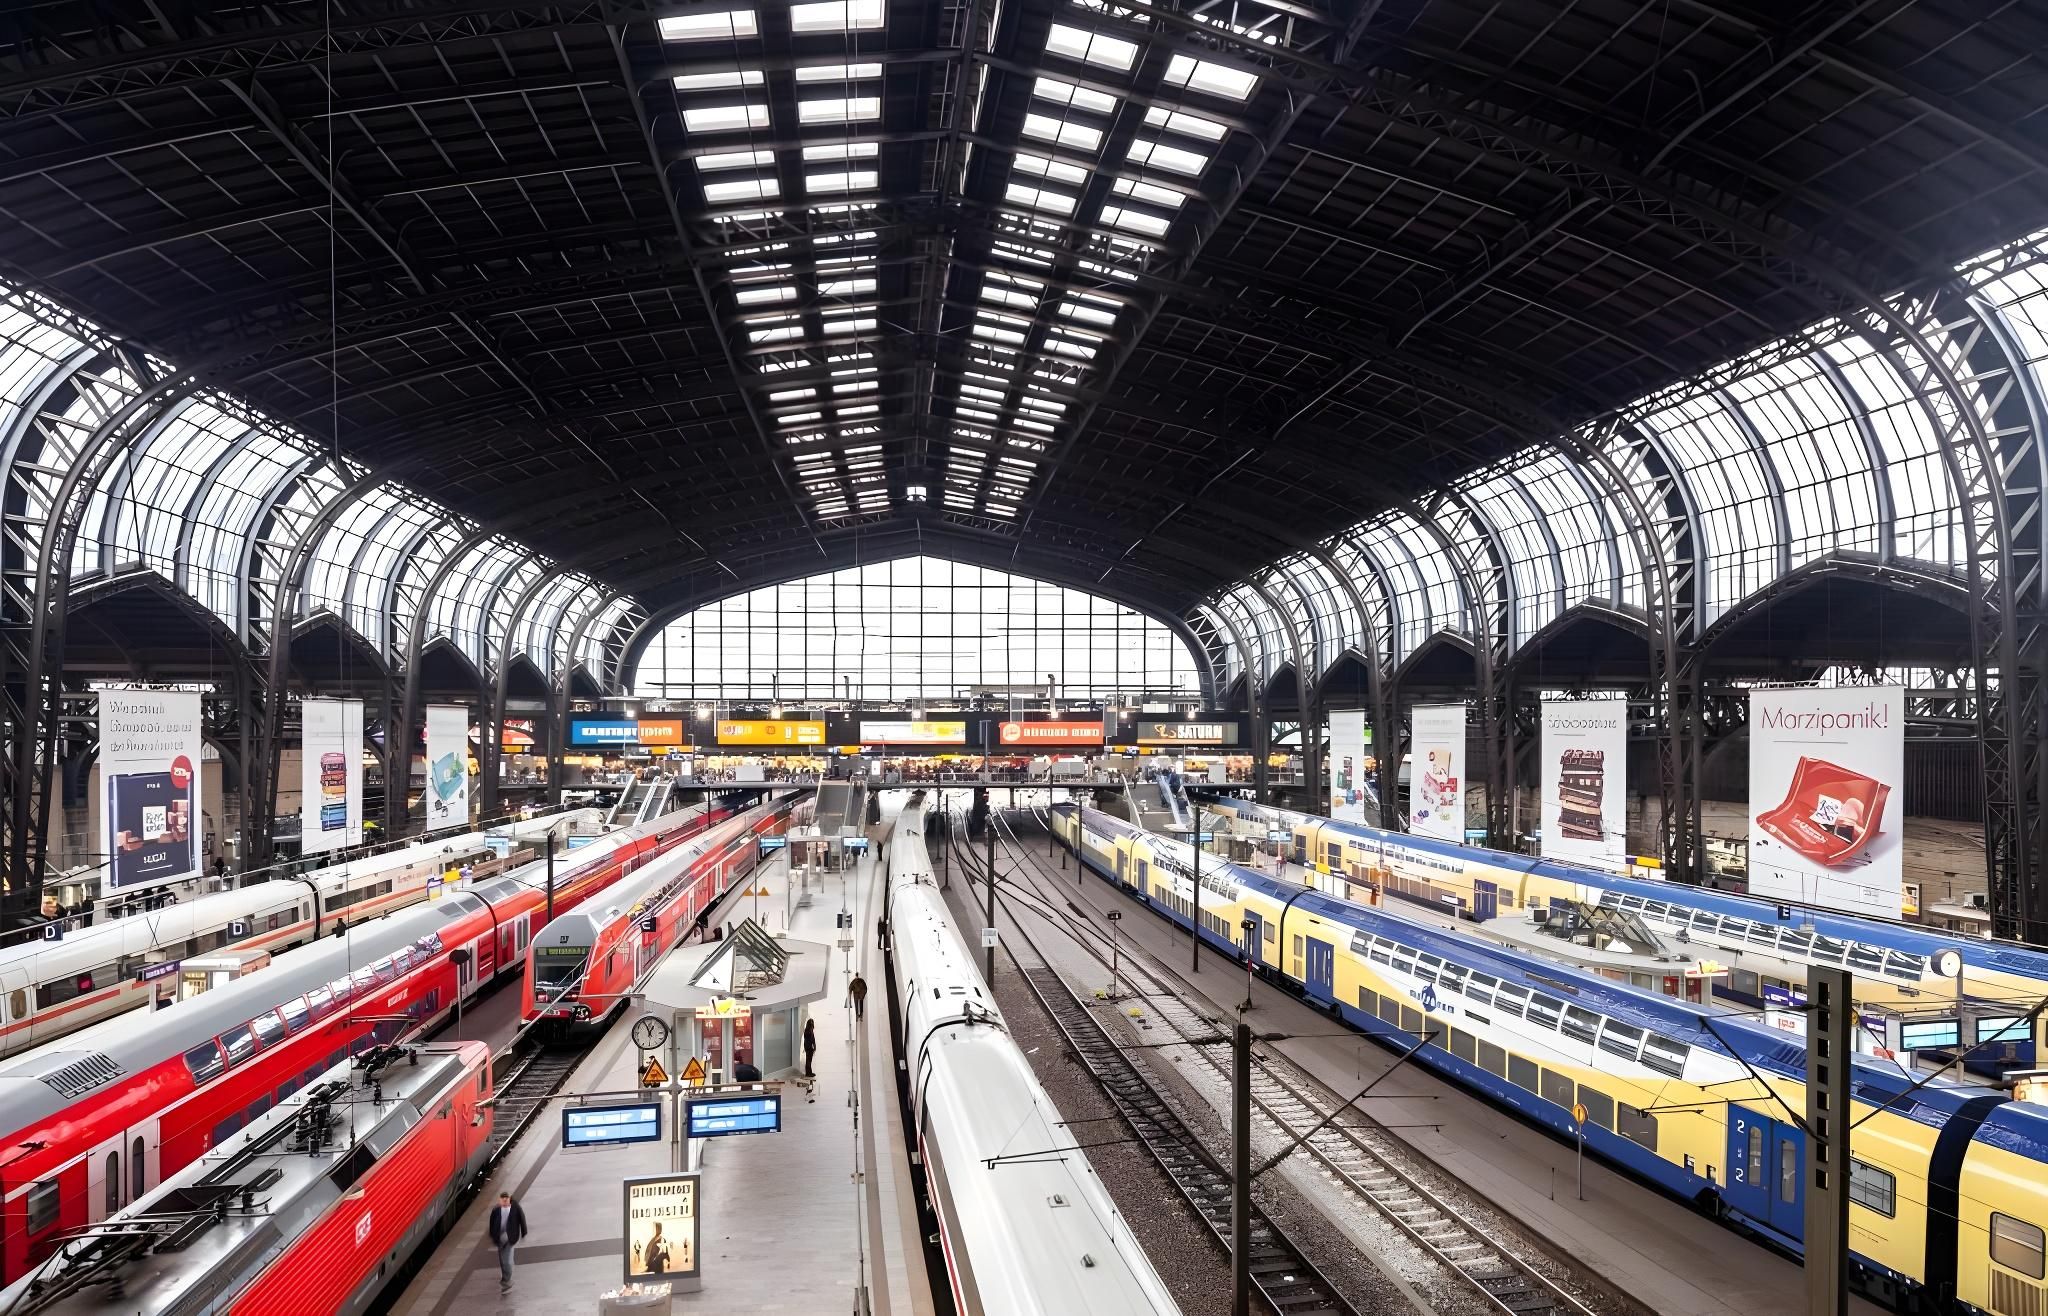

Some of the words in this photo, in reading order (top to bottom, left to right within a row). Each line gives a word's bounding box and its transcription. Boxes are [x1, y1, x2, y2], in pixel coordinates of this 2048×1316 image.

[1761, 701, 1888, 736] Marzipanik!
[45, 926, 55, 938] D
[1737, 1119, 1744, 1133] 2
[1736, 1168, 1743, 1182] 2
